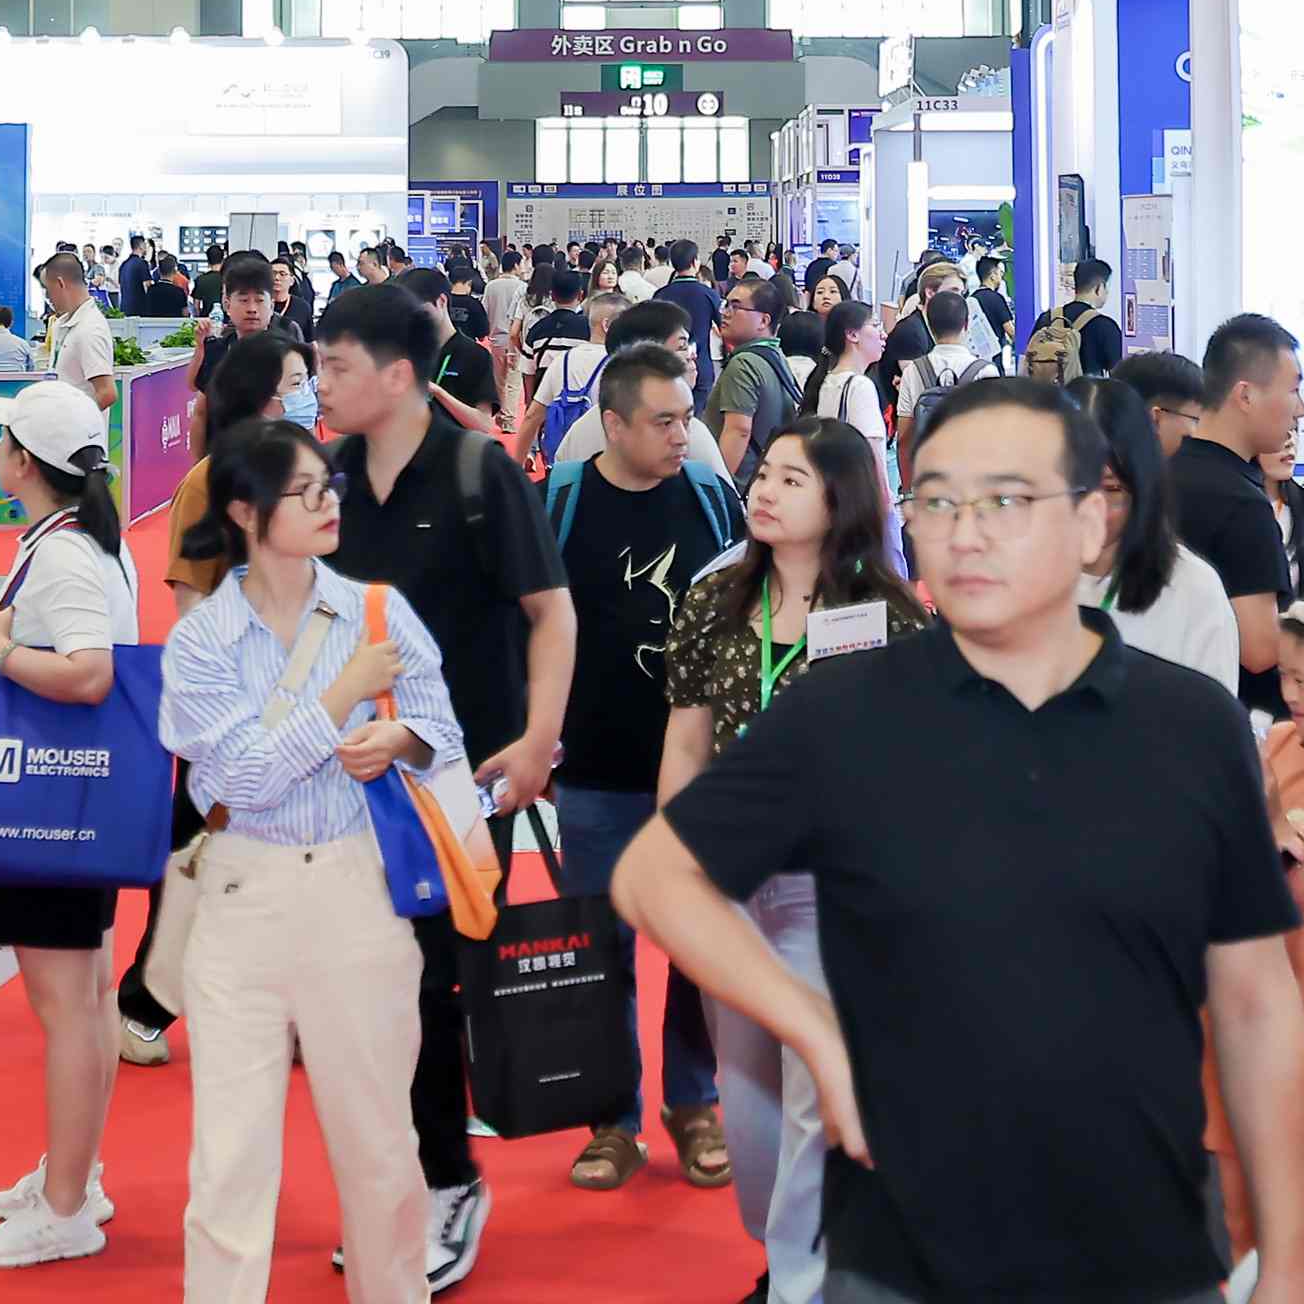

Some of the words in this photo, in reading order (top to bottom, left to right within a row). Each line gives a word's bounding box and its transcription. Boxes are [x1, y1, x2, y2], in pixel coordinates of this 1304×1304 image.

[551, 35, 615, 56] 外卖区
[620, 36, 673, 53] Grab
[678, 40, 692, 53] n
[697, 36, 728, 53] Go
[917, 99, 959, 112] 11C33
[26, 748, 110, 767] MOUSER
[25, 764, 110, 778] ELECTRONICS
[498, 932, 593, 960] HANKAI
